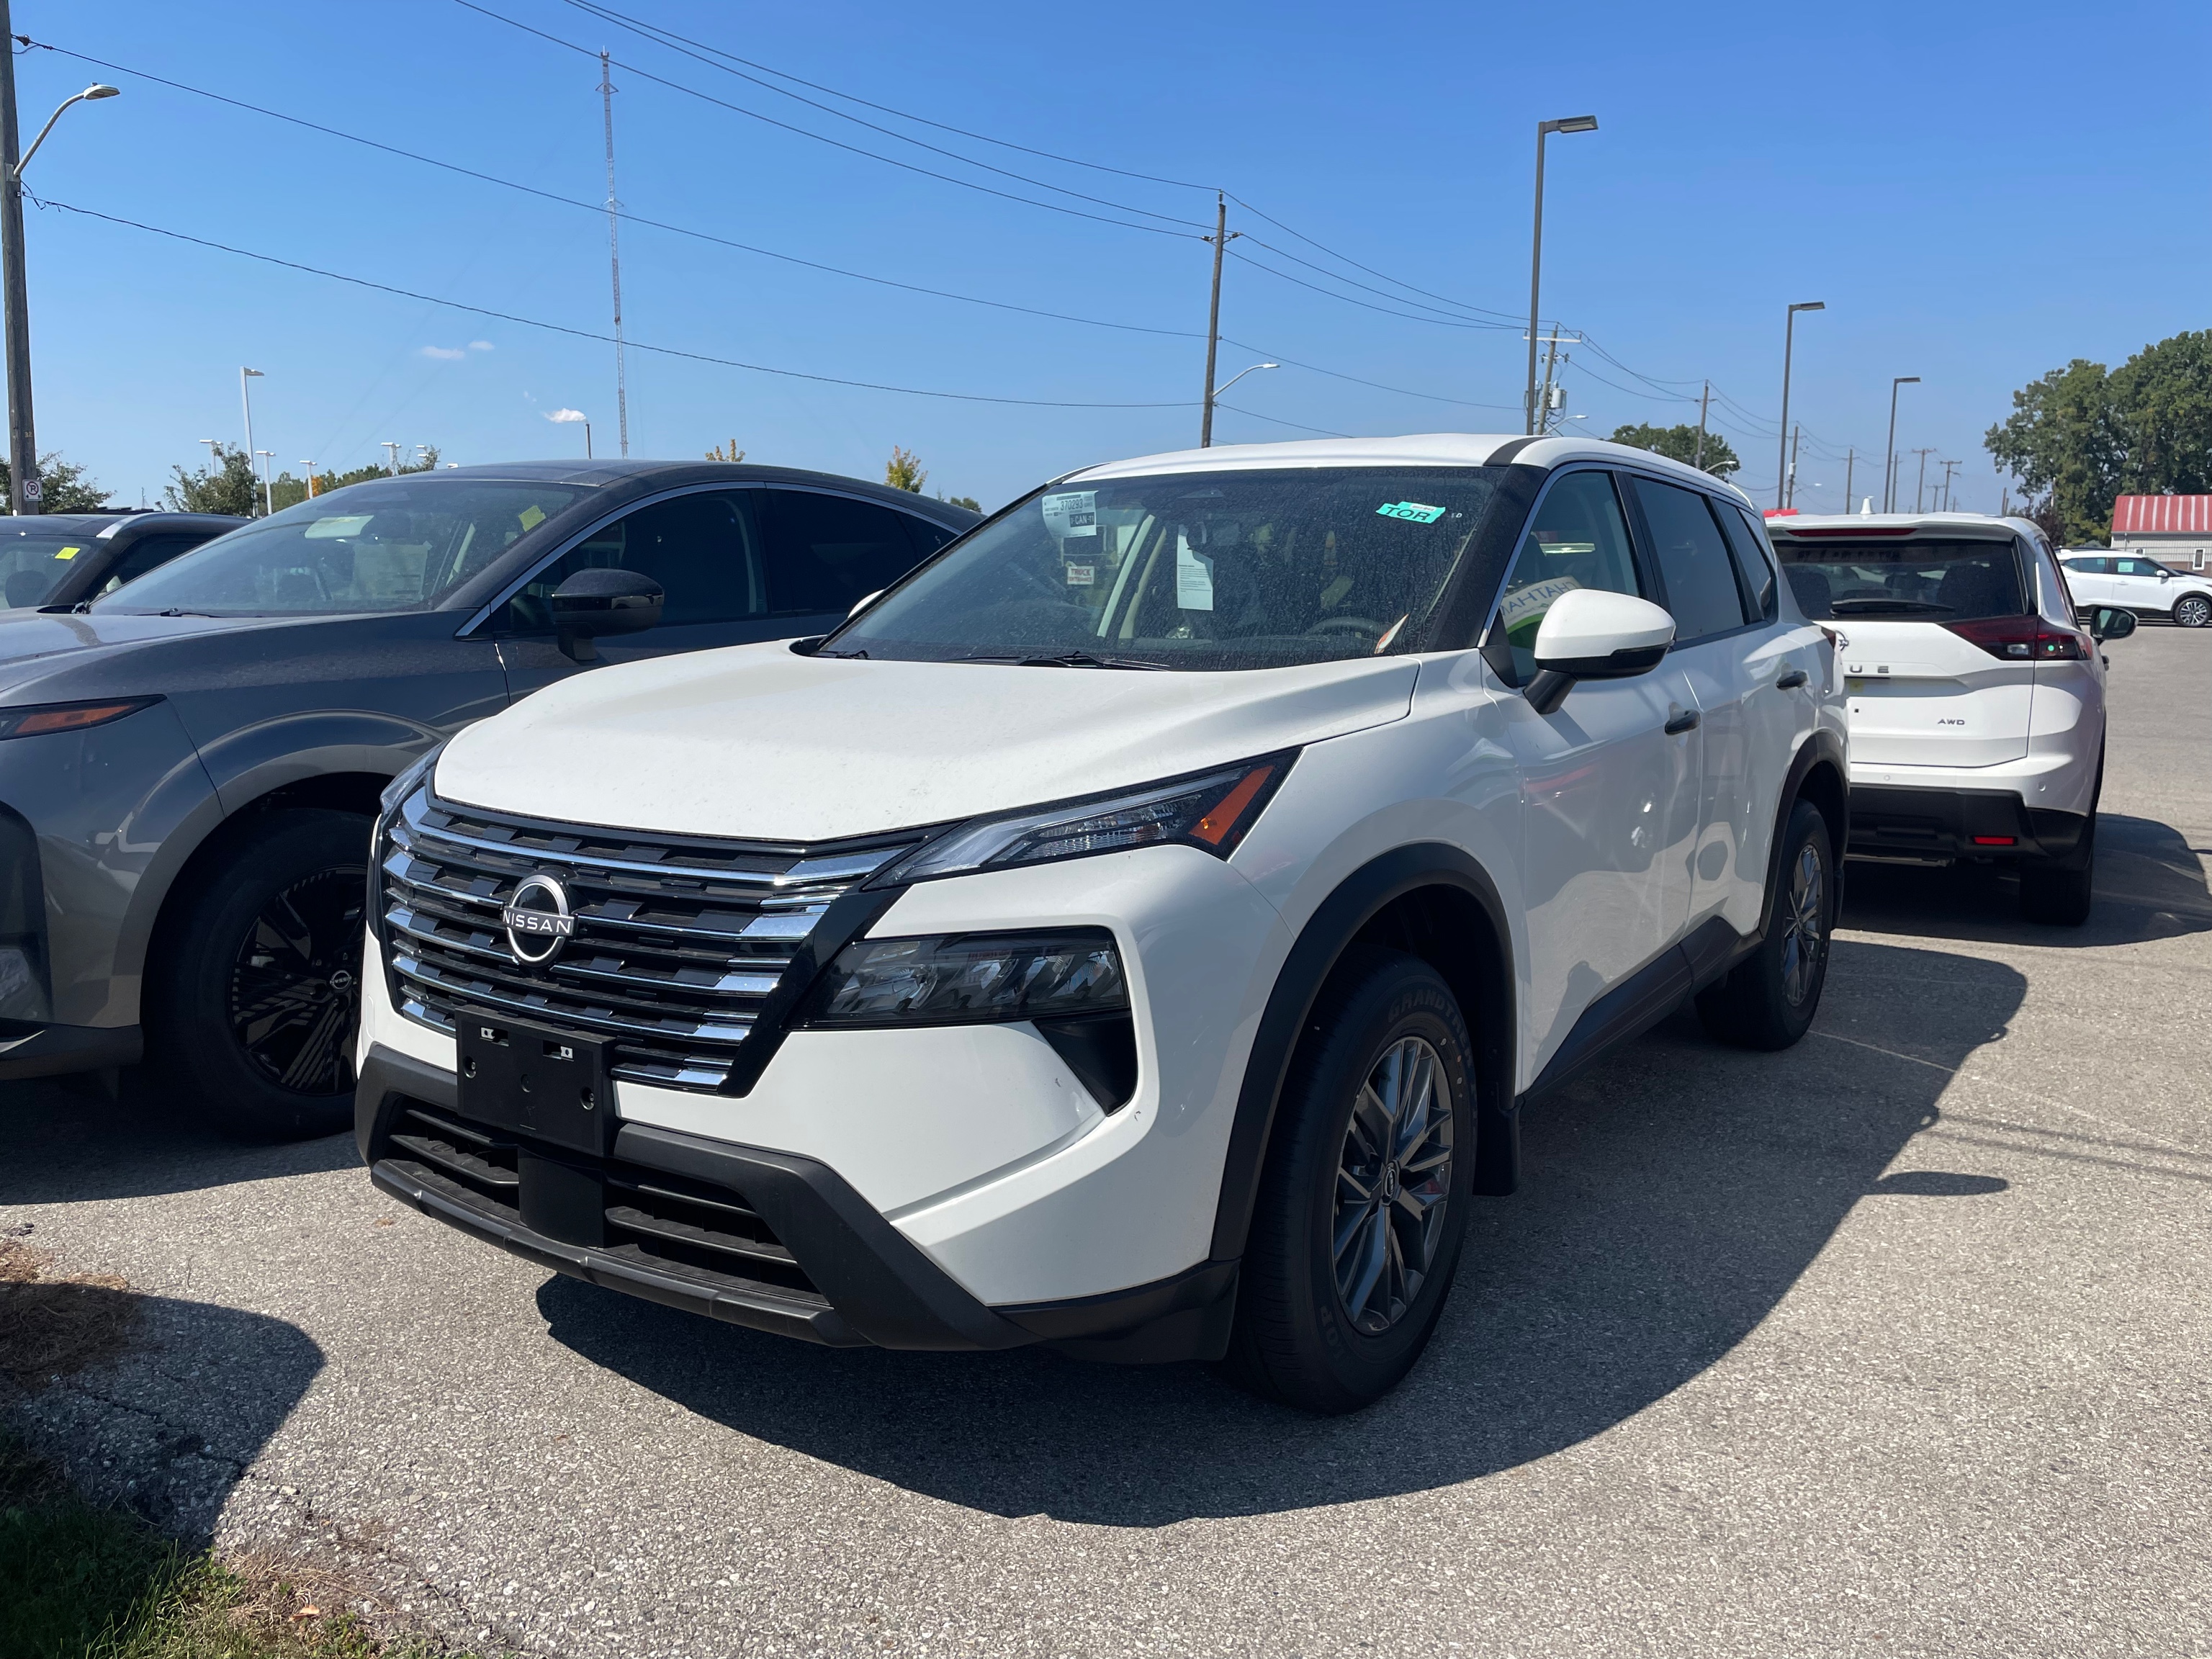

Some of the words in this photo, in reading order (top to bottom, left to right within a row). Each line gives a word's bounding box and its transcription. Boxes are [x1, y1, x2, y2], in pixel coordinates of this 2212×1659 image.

[1061, 498, 1084, 511] 370293
[1386, 506, 1431, 521] TOR
[503, 909, 571, 933] NISSAN
